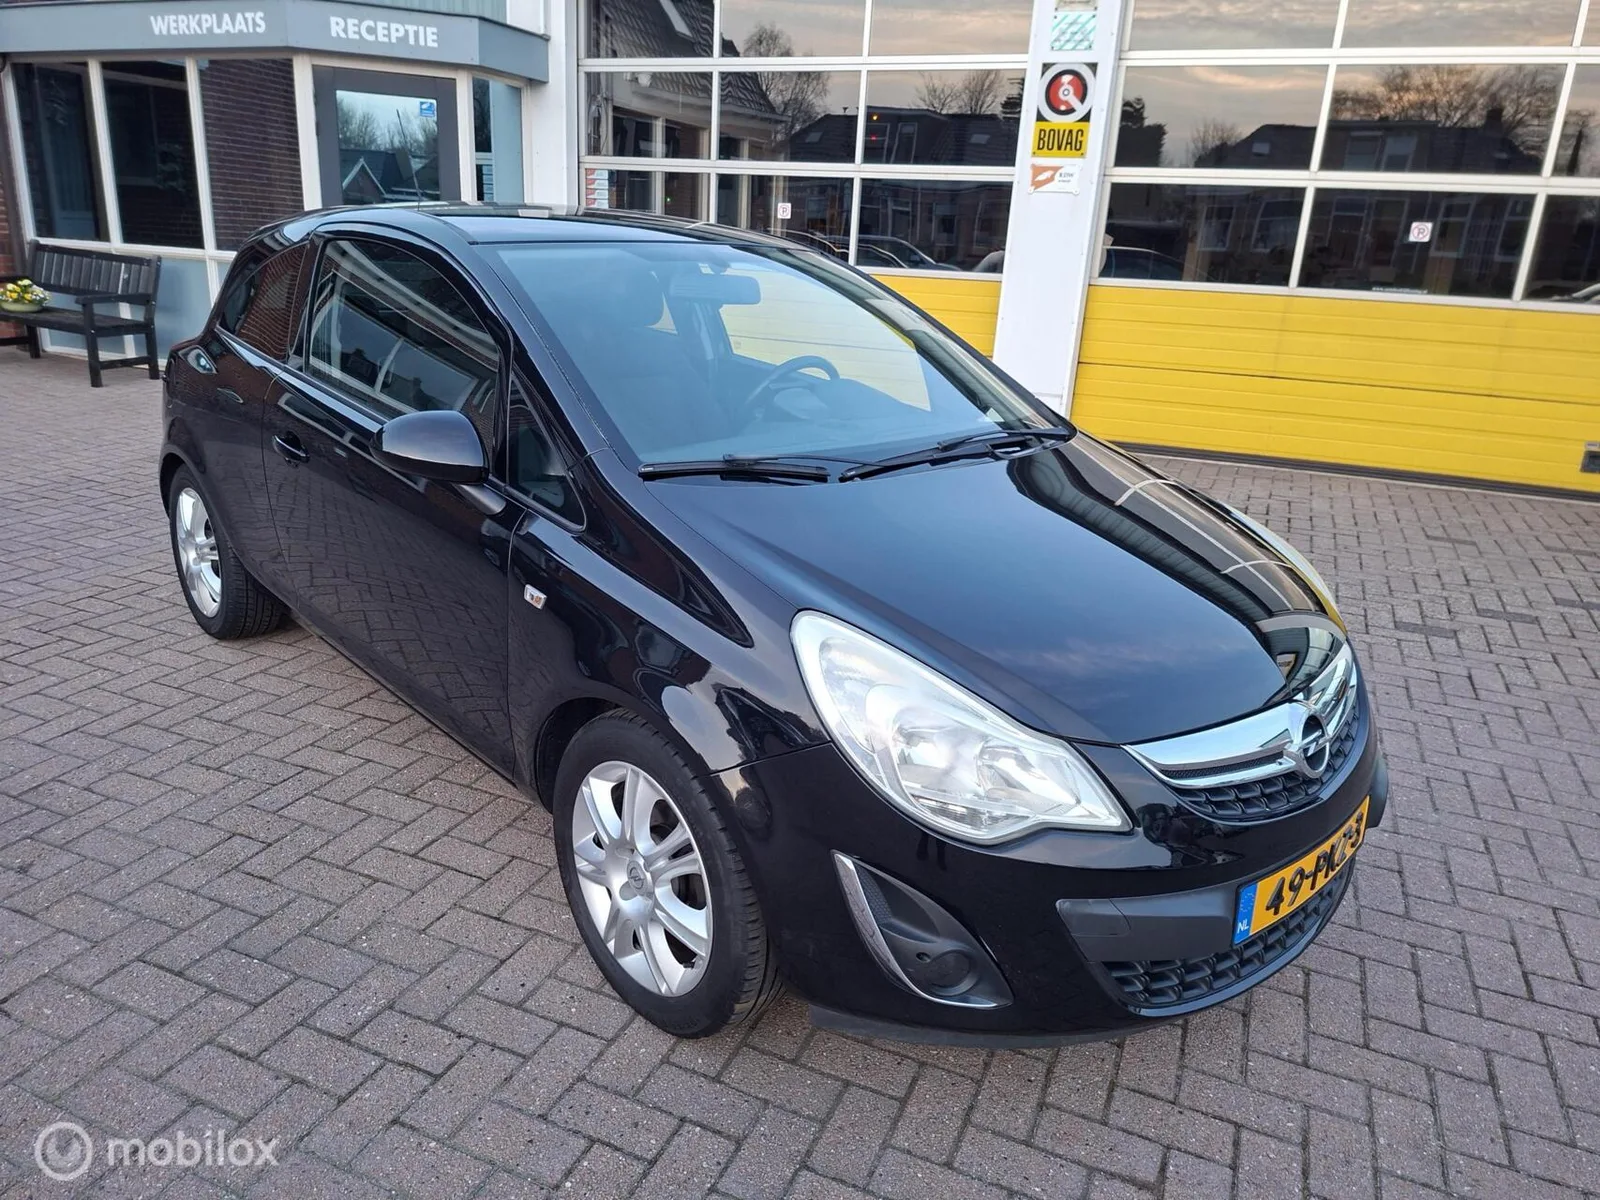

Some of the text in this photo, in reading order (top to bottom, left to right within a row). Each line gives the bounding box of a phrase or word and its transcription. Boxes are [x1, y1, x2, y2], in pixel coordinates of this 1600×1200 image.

[150, 12, 266, 35] WERKPLAATS
[330, 16, 439, 48] RECEPTIE
[1037, 128, 1084, 151] BOVAG
[1237, 918, 1249, 934] NL
